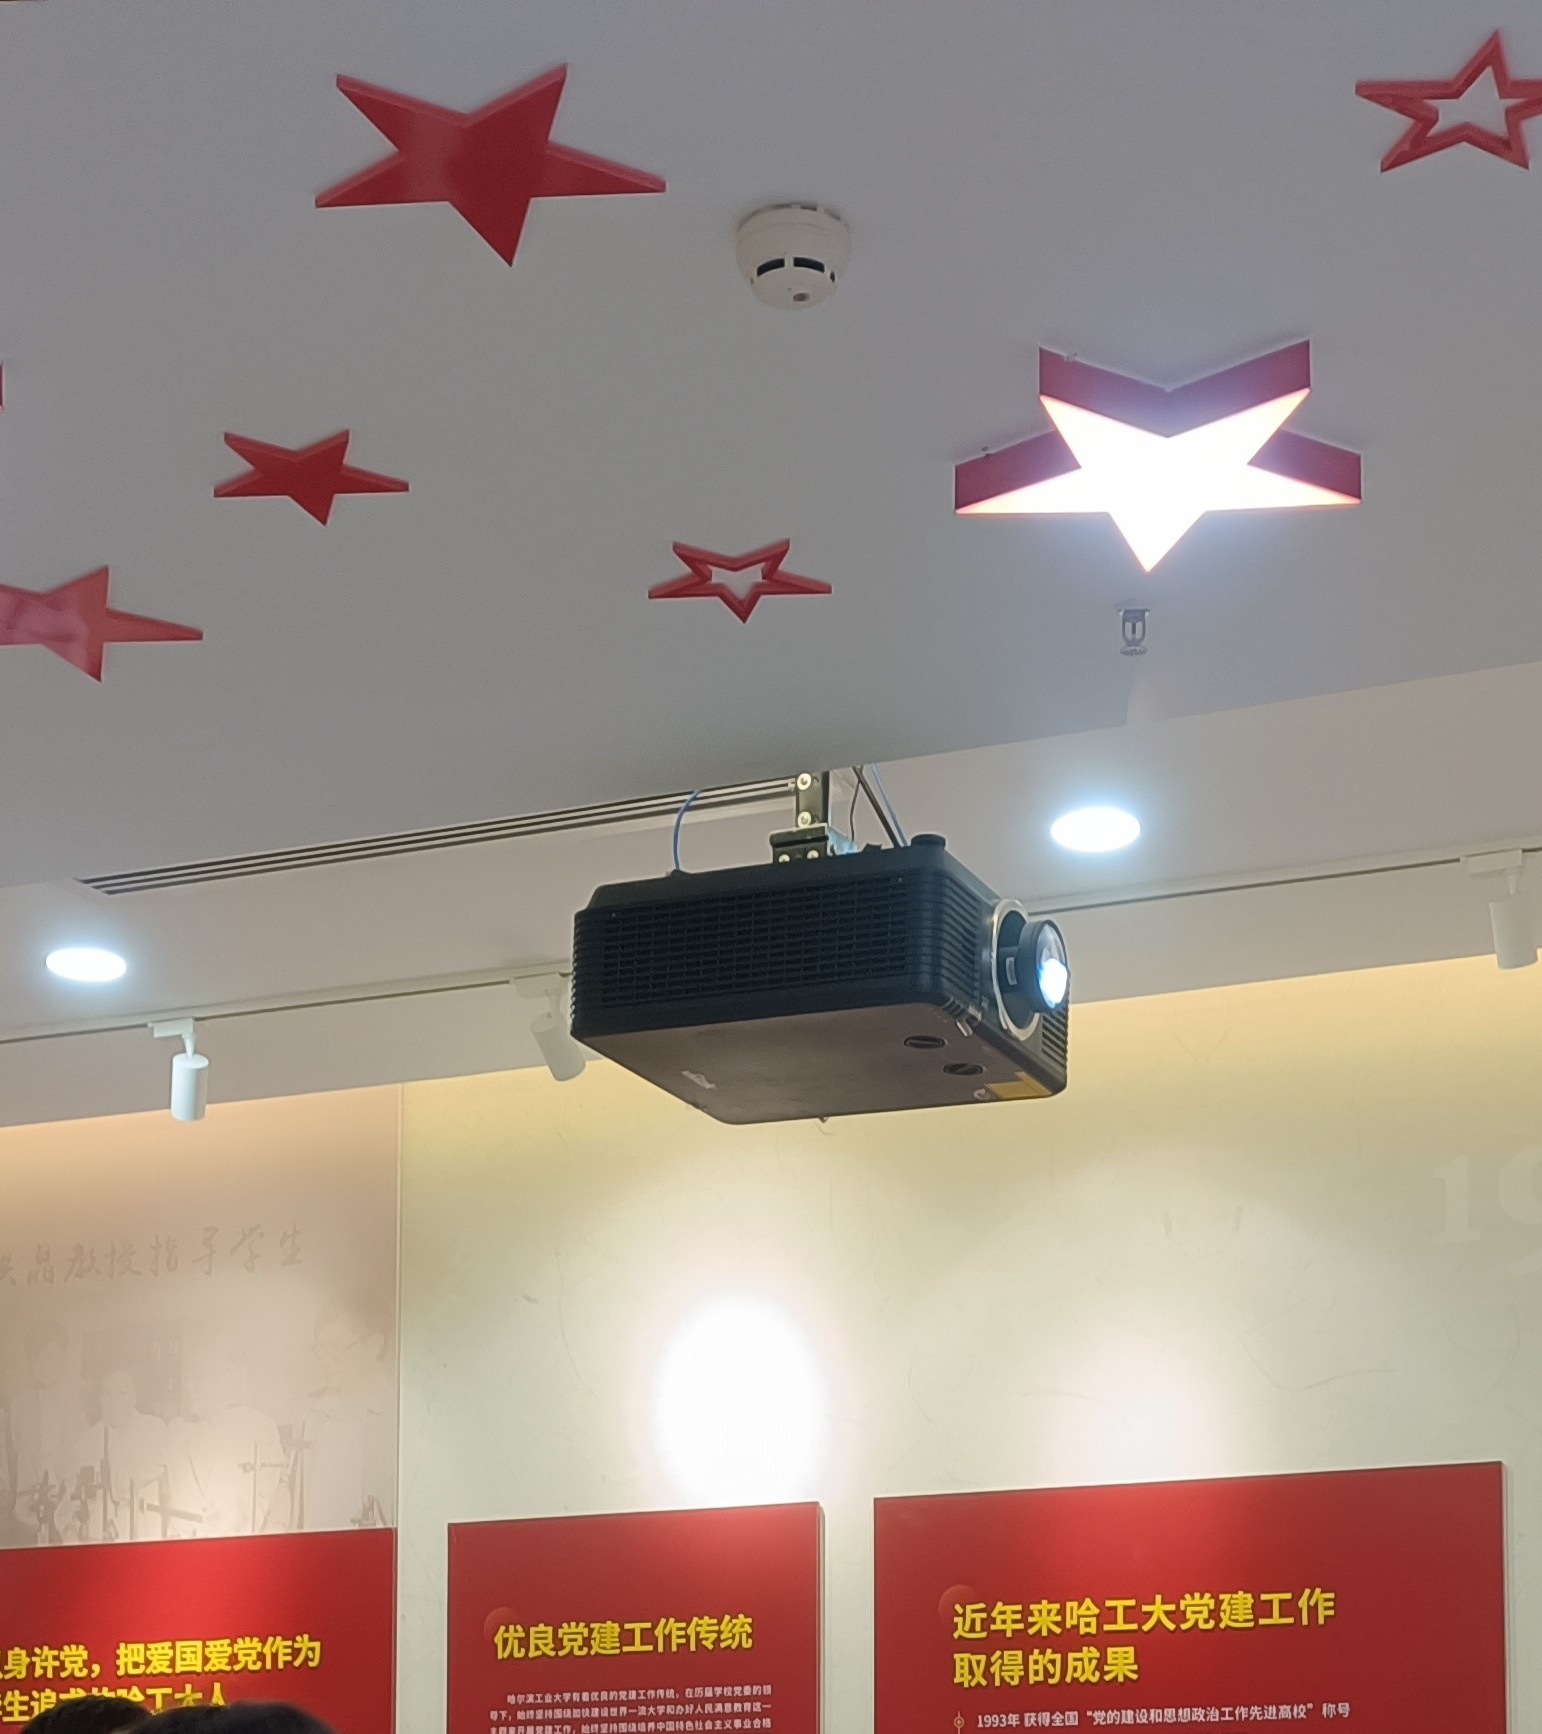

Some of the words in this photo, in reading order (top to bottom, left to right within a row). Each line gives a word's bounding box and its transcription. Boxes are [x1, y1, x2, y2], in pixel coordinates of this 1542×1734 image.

[952, 1587, 1336, 1640] 近年来哈工大党建工作
[493, 1613, 754, 1660] 优良党建工作传统
[952, 1645, 1139, 1688] 取得的成果
[977, 1713, 1020, 1728] 1993年
